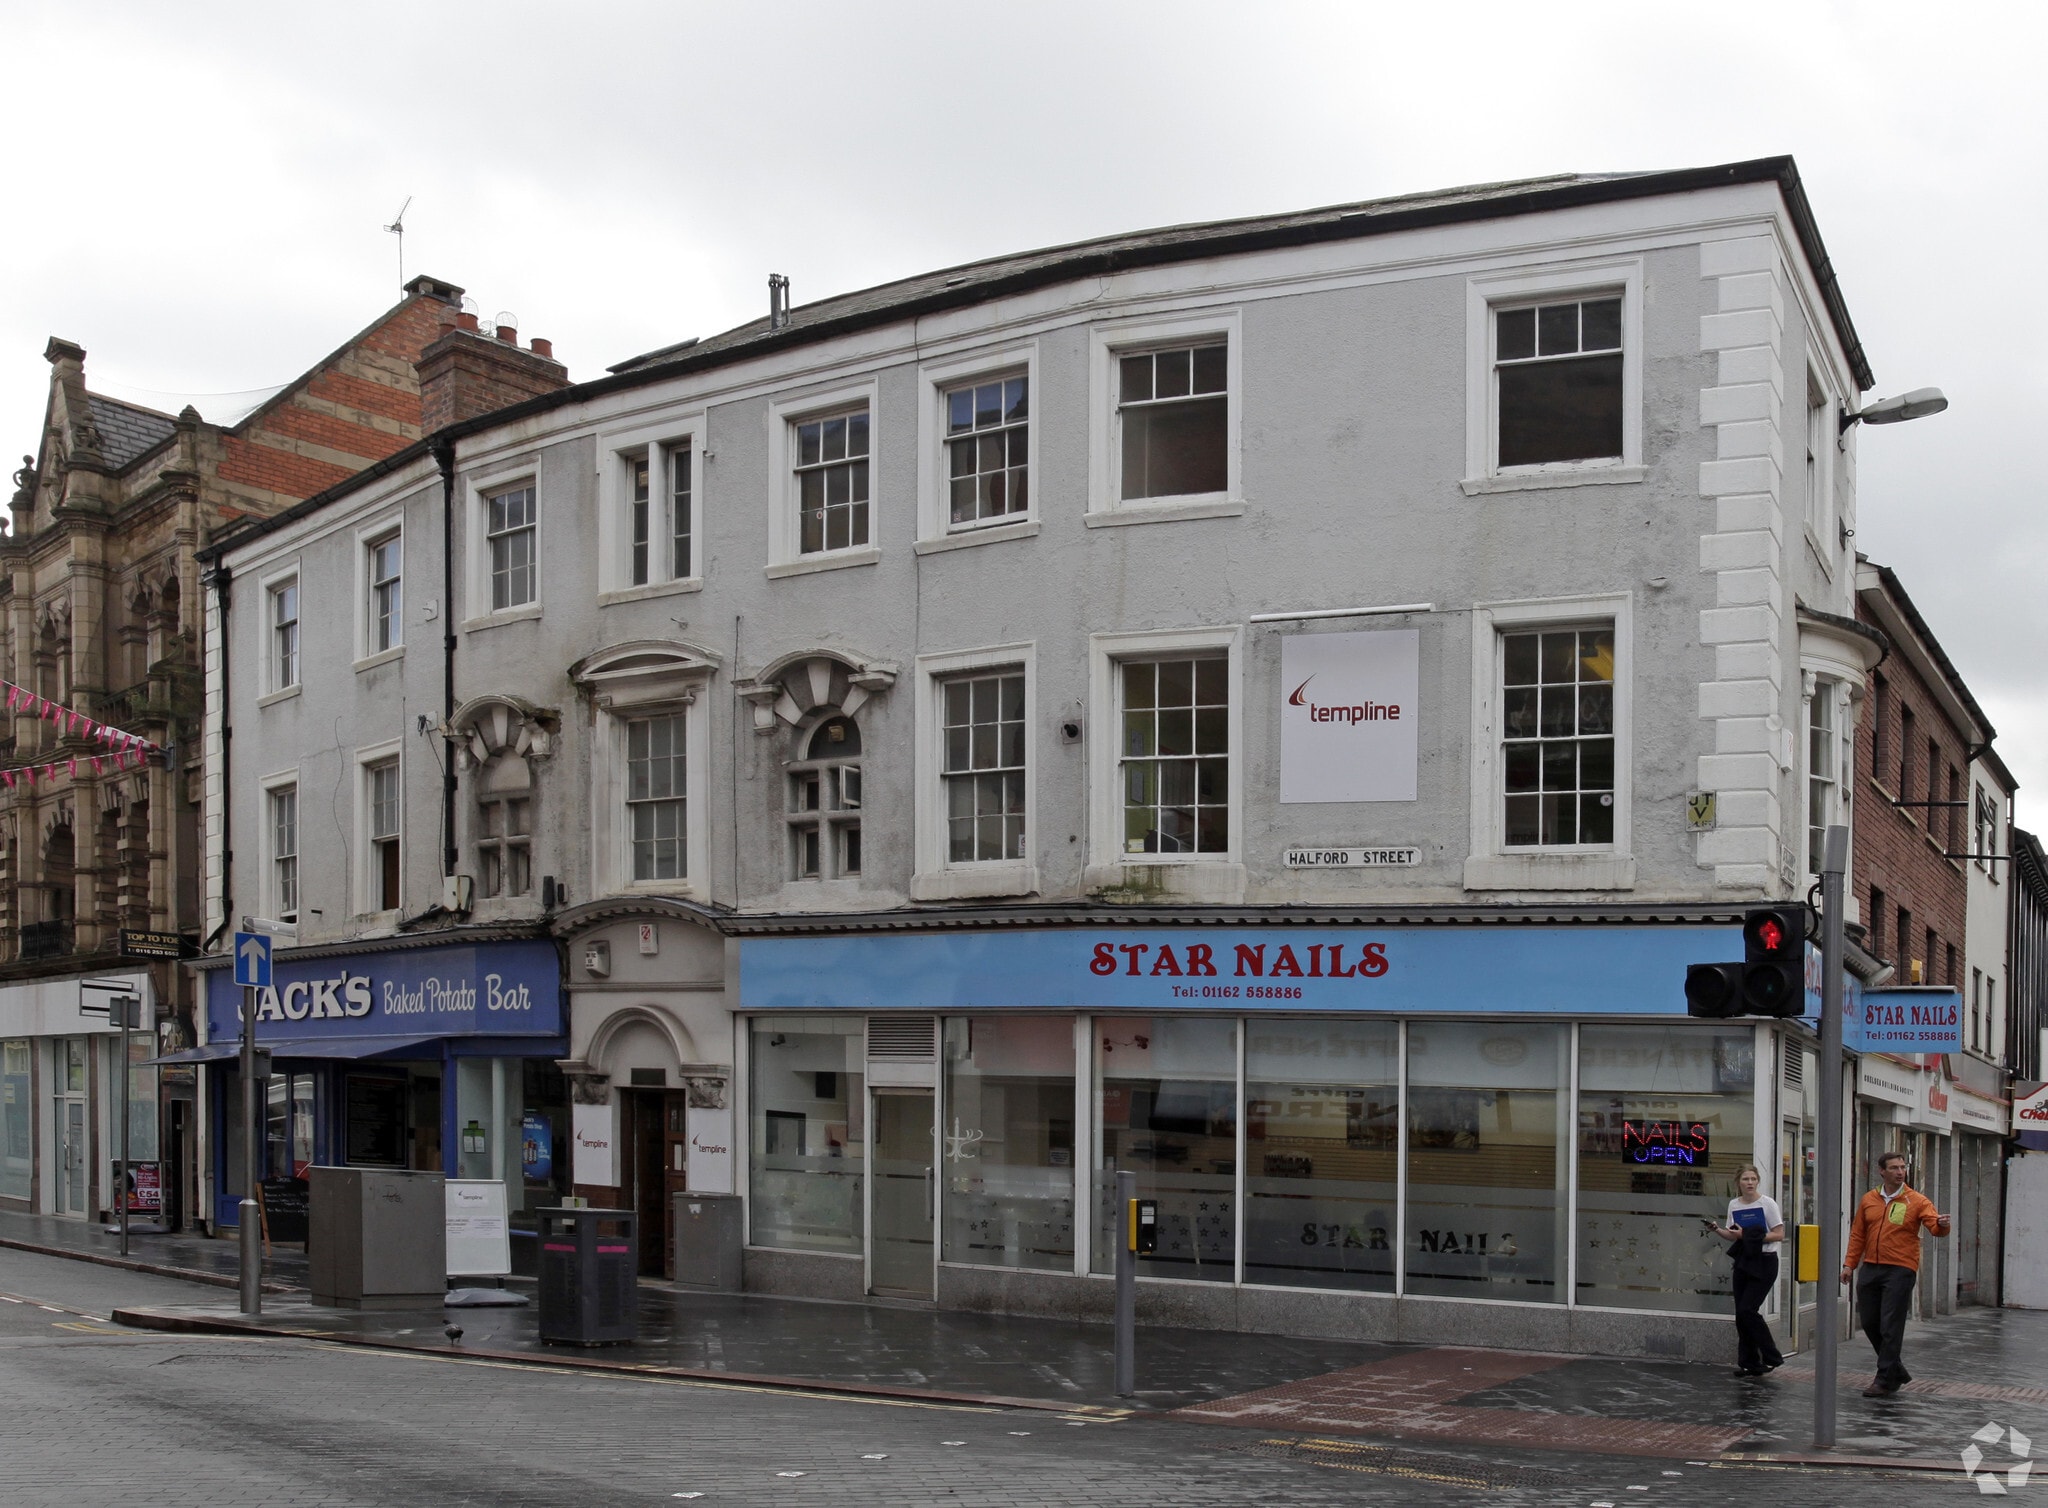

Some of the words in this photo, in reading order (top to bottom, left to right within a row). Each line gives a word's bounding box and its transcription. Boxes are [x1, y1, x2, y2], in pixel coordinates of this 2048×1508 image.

[1310, 700, 1401, 727] templine
[1288, 852, 1349, 866] HALFORD
[1363, 850, 1415, 864] STREET
[126, 933, 146, 941] TOP
[146, 935, 160, 943] TO
[1089, 942, 1218, 977] STAR
[1233, 942, 1390, 978] NAILS
[383, 980, 426, 1015] Baked
[426, 977, 477, 1013] Potato
[485, 973, 532, 1011] Bar
[1172, 985, 1199, 998] Tel:
[1202, 986, 1241, 998] 01162
[1246, 986, 1303, 999] 558886
[1865, 1005, 1905, 1025] STAR
[1910, 1005, 1958, 1025] NAILS
[1866, 1031, 1885, 1040] Tel:
[1886, 1031, 1915, 1041] 01162
[1918, 1031, 1957, 1041] 558886
[582, 1139, 608, 1149] templine
[1624, 1121, 1707, 1152] NAILS
[699, 1144, 726, 1154] templine
[1633, 1147, 1693, 1164] OPEN
[139, 1190, 159, 1198] £54
[1301, 1222, 1389, 1250] STAR
